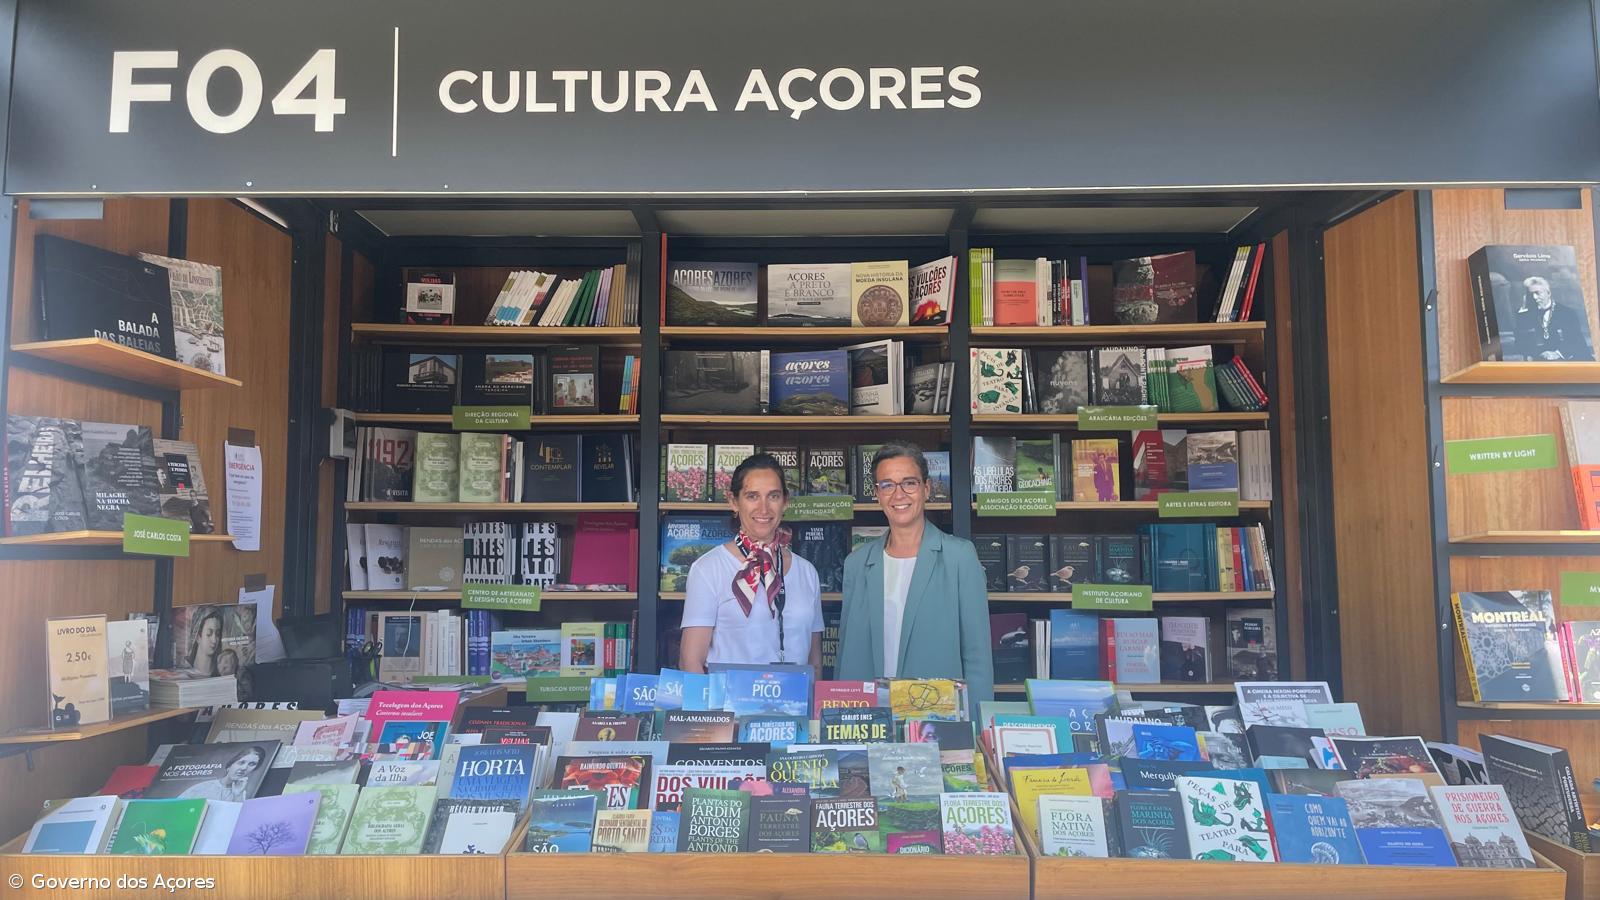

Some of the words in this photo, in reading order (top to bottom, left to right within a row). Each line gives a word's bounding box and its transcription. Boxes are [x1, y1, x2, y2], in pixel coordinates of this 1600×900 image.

[109, 48, 346, 133] F04
[438, 69, 718, 113] CULTURA
[734, 65, 982, 120] AÇORES
[673, 268, 713, 288] AÇORES
[713, 271, 753, 287] AZORES
[787, 272, 825, 283] AÇORES
[797, 280, 831, 289] PRETO
[784, 289, 791, 297] E
[792, 288, 834, 297] BRANCO
[151, 312, 159, 324] A
[118, 319, 160, 339] BALADA
[118, 335, 161, 353] BALEIAS
[785, 359, 830, 373] açores
[785, 374, 830, 386] azores
[464, 411, 488, 419] DIREÇÃO
[1088, 414, 1122, 422] ARAUCÁRIA
[1123, 414, 1148, 423] EDIÇÕES
[670, 453, 704, 467] AÇORES
[1469, 451, 1501, 461] WRITTEN
[1503, 450, 1513, 459] BY
[1514, 449, 1536, 458] LIGHT
[529, 463, 572, 471] CONTEMPLAR
[809, 455, 844, 469] AÇORES
[974, 466, 983, 476] AS
[975, 476, 987, 485] DOS
[987, 475, 1013, 486] AÇORES
[1018, 478, 1053, 489] GEOCACHING
[96, 491, 127, 499] MILAGRE
[1024, 497, 1047, 505] AÇORES
[980, 503, 1018, 511] ASSOCIAÇÃO
[464, 522, 504, 534] AÇORES
[667, 528, 700, 540] AÇORES
[133, 529, 146, 538] JOSÉ
[146, 530, 166, 540] CARLOS
[166, 532, 182, 541] COSTA
[467, 589, 489, 597] CENTRO
[499, 590, 535, 598] ARTESANATO
[508, 597, 533, 605] AÇORES
[1471, 611, 1547, 624] MONTREAL
[57, 627, 76, 636] LIVRO
[76, 626, 86, 634] DO
[86, 625, 97, 633] DIA
[632, 685, 656, 700] SÃO
[752, 684, 782, 698] PICO
[378, 702, 410, 711] Tecelagem
[822, 699, 870, 708] BENTO
[669, 715, 731, 723] MAL-AMANHADOS
[1108, 715, 1161, 725] LAUDALINO
[417, 731, 434, 741] JOE
[749, 726, 795, 743] AÇORES
[826, 725, 869, 740] TEMAS
[871, 724, 887, 739] DE
[173, 762, 222, 771] FOTOGRAFIA
[460, 759, 525, 777] HORTA
[941, 764, 972, 774] AÇORES
[180, 769, 213, 778] AÇORES
[375, 774, 387, 782] da
[389, 773, 408, 782] Ilha
[1141, 770, 1182, 783] Mergulho
[1187, 779, 1217, 802] PEÇAS
[1218, 800, 1232, 811] DE
[1444, 791, 1500, 803] PRISIONEIRO
[691, 797, 729, 807] PLANTAS
[730, 800, 743, 808] DO
[1451, 803, 1464, 813] DE
[1464, 802, 1503, 813] GUERRA
[690, 804, 742, 819] JARDIM
[1131, 811, 1173, 819] MARINHA
[1304, 803, 1323, 815] COMO
[690, 814, 741, 827] ANTÓNIO
[759, 813, 800, 822] FAUNA
[815, 808, 875, 832] AÇORES
[946, 805, 1005, 826] AÇORES
[1051, 811, 1093, 822] FLORA
[1308, 815, 1325, 827] QUEM
[1326, 816, 1339, 827] VAI
[1339, 817, 1348, 828] AO
[1454, 814, 1473, 824] NOS
[1475, 813, 1510, 825] AÇORES
[688, 824, 740, 839] BORGES
[1052, 821, 1094, 831] NATIVA
[597, 828, 621, 840] PORTO
[622, 828, 646, 840] SANTO
[1067, 830, 1095, 838] AÇORES
[1200, 827, 1237, 842] TEATRO
[1311, 827, 1347, 839] HORIZONTE
[533, 838, 559, 852] SÃO
[1222, 840, 1249, 856] PARA
